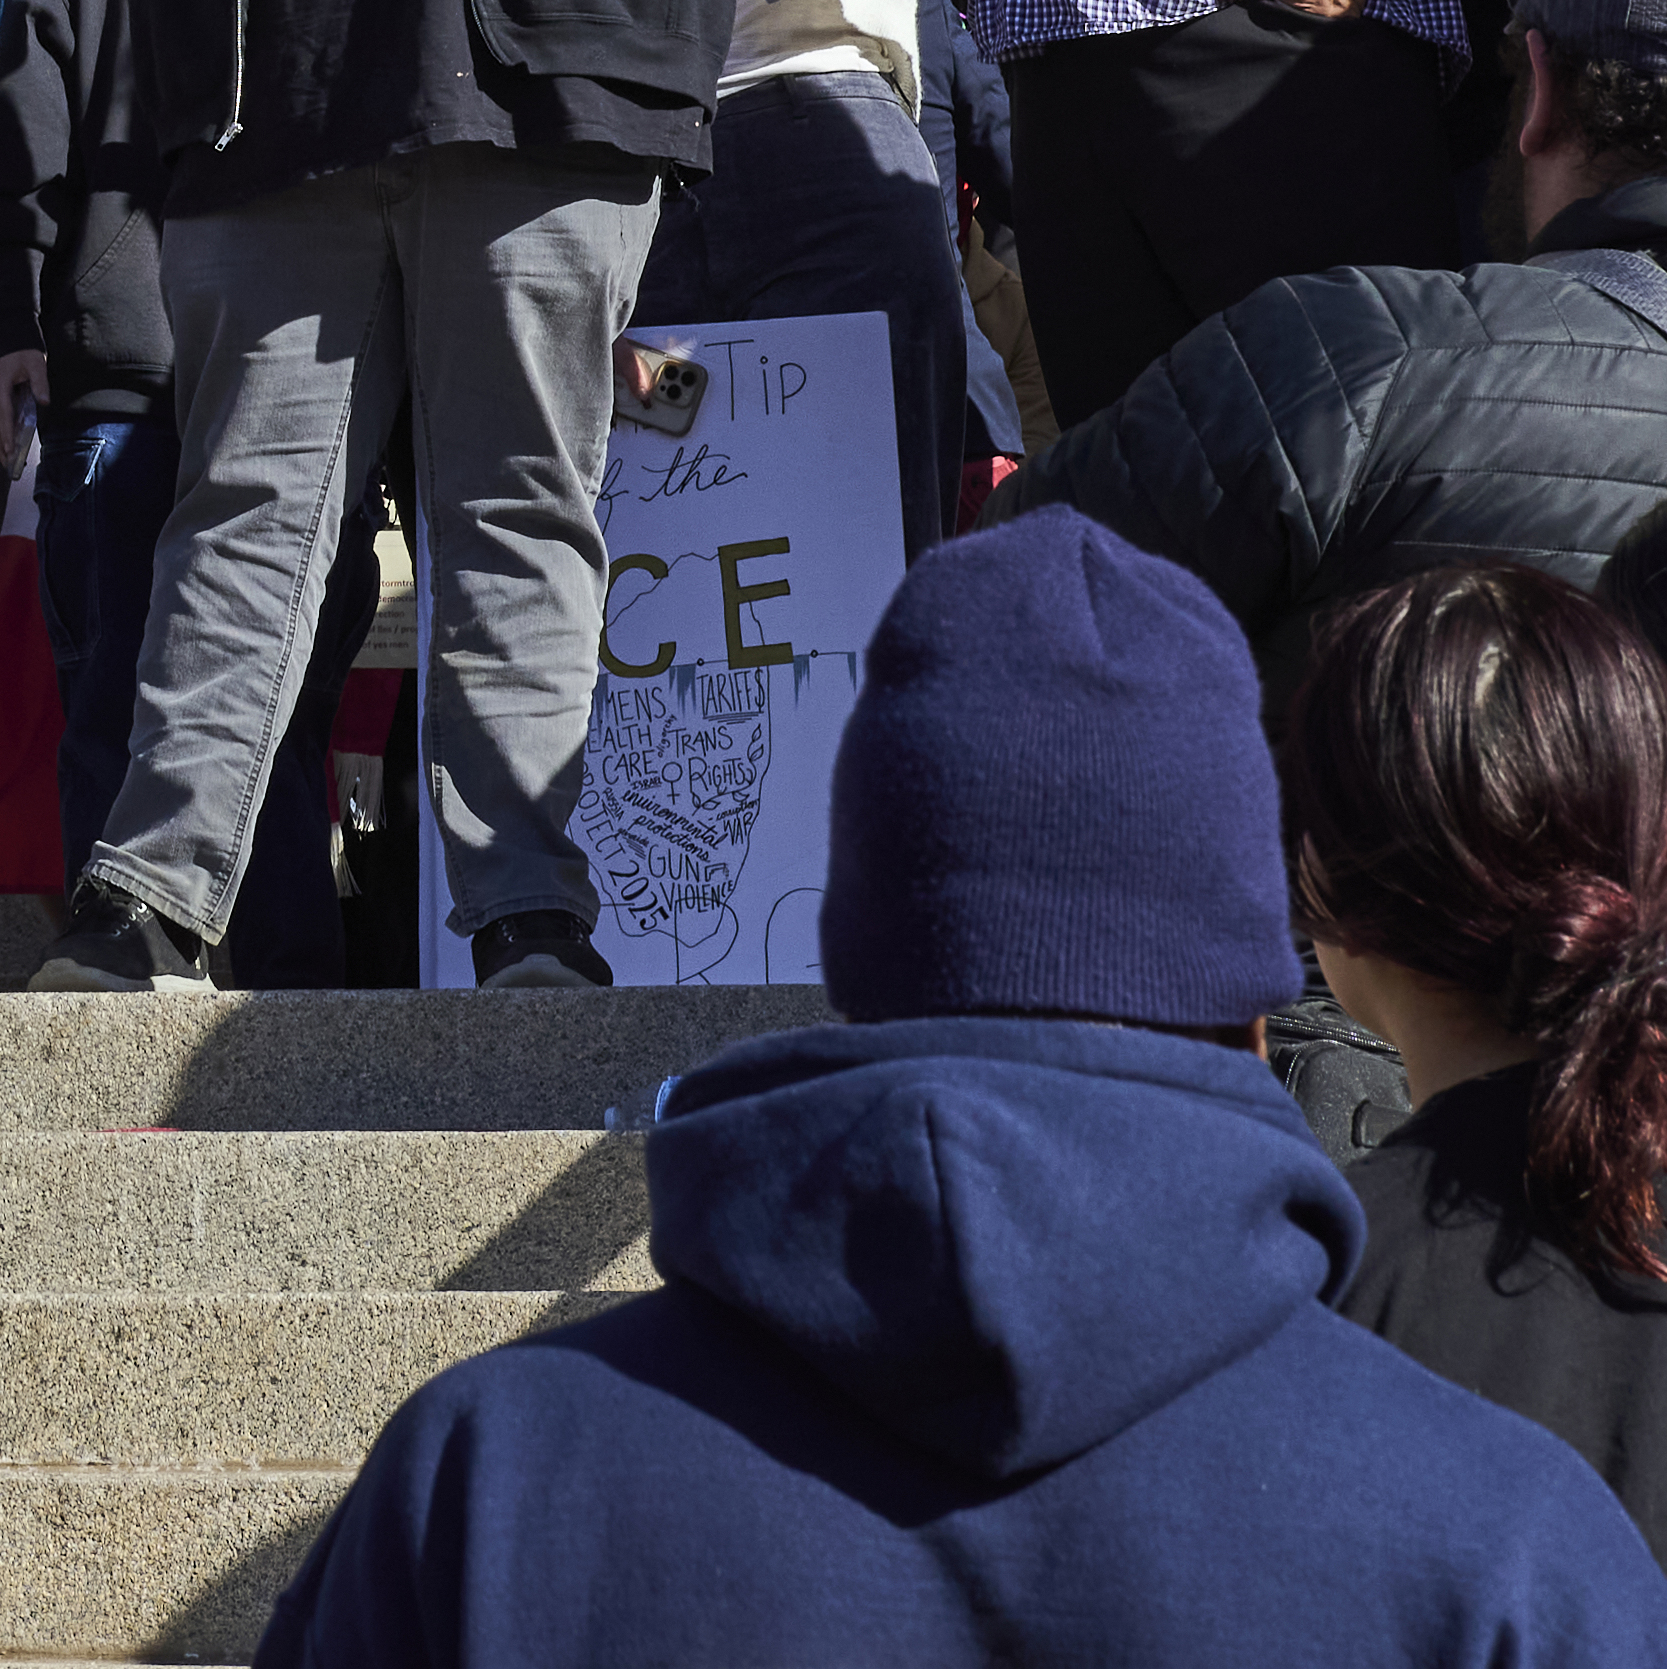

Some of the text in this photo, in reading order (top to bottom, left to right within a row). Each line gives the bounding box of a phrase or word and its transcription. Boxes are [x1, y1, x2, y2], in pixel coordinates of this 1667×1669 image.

[597, 444, 749, 537] f the
[696, 668, 766, 718] TARIFF$
[667, 725, 734, 759] TRANS
[602, 749, 659, 785] CARE
[631, 776, 663, 790] ISRAEL
[622, 789, 728, 850] environmental
[627, 814, 711, 863] protections
[723, 811, 754, 846] WAR
[648, 843, 700, 883] GUN
[607, 859, 670, 931] 2025
[660, 879, 734, 914] VIOLENCE
